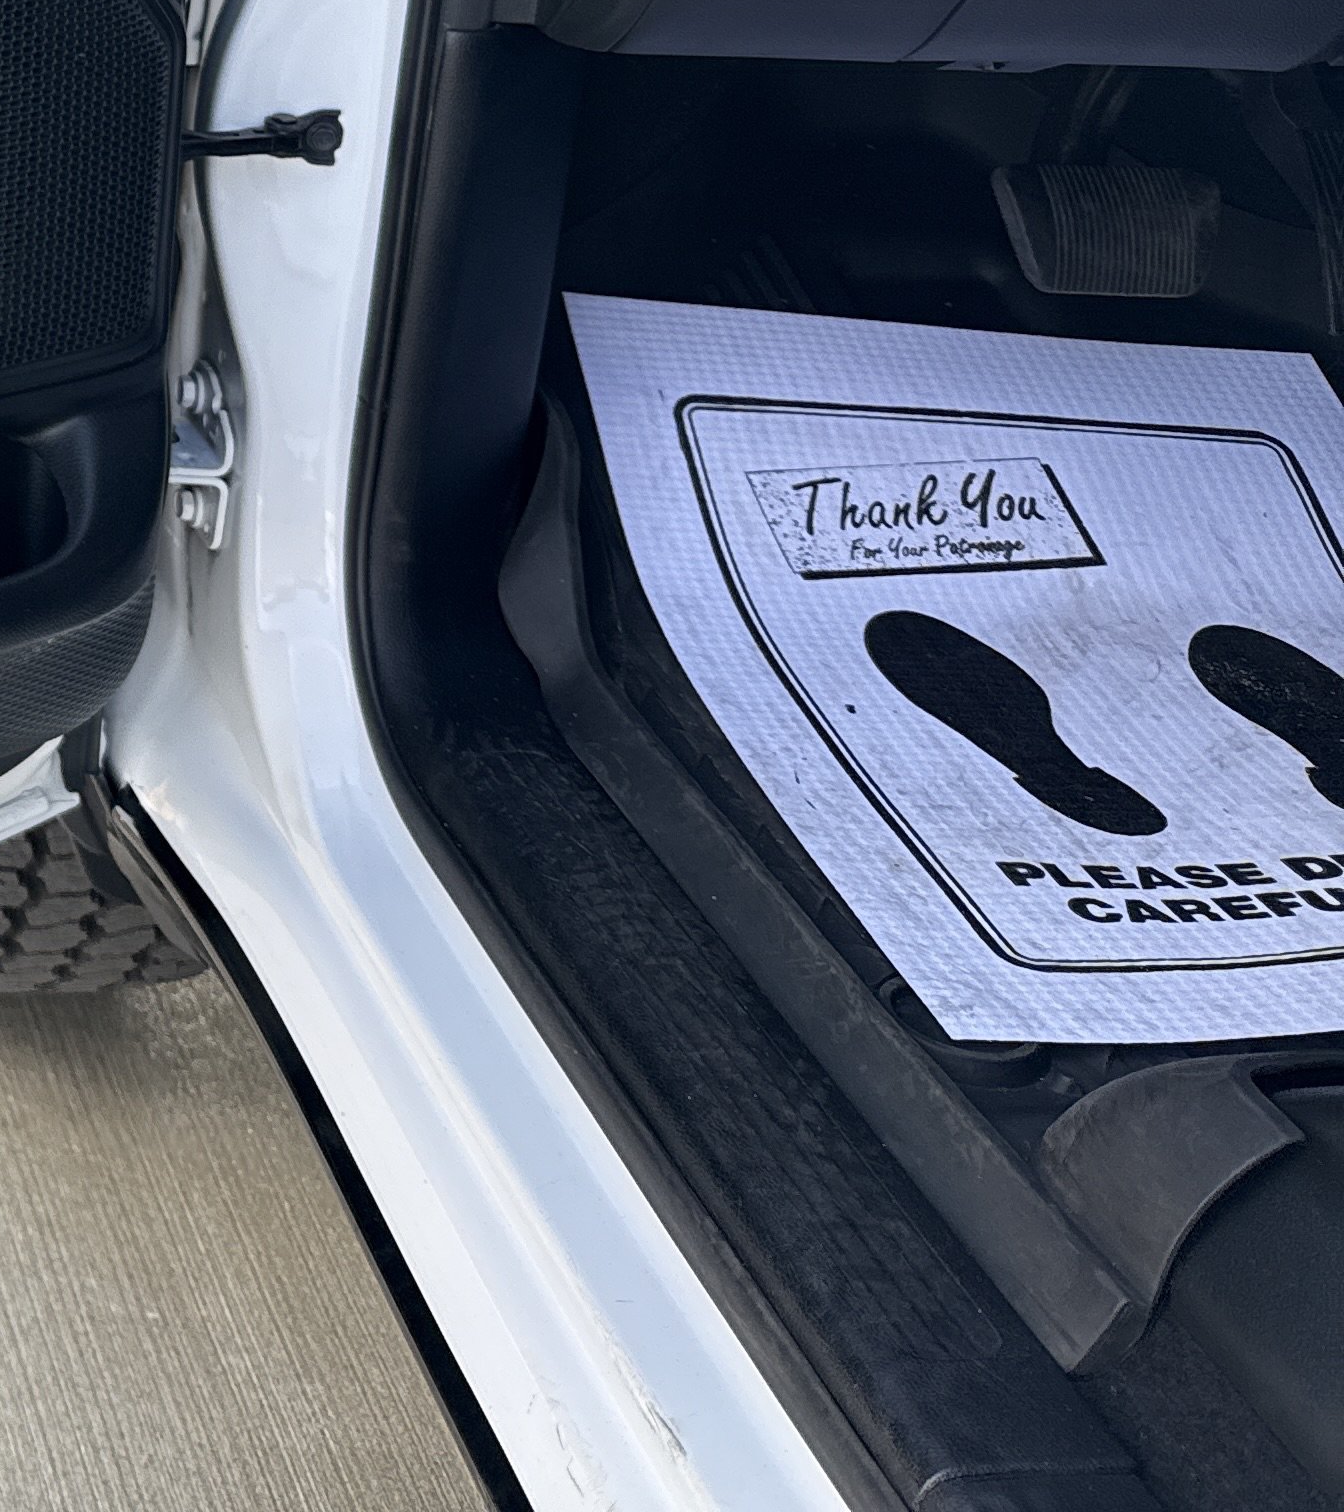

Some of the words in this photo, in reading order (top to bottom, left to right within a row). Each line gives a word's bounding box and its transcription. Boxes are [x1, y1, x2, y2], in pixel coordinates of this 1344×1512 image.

[792, 473, 948, 535] Thank
[961, 468, 1046, 528] You
[850, 538, 883, 560] For
[888, 537, 928, 559] Your
[995, 860, 1278, 890] PLEASE
[1279, 854, 1344, 881] D
